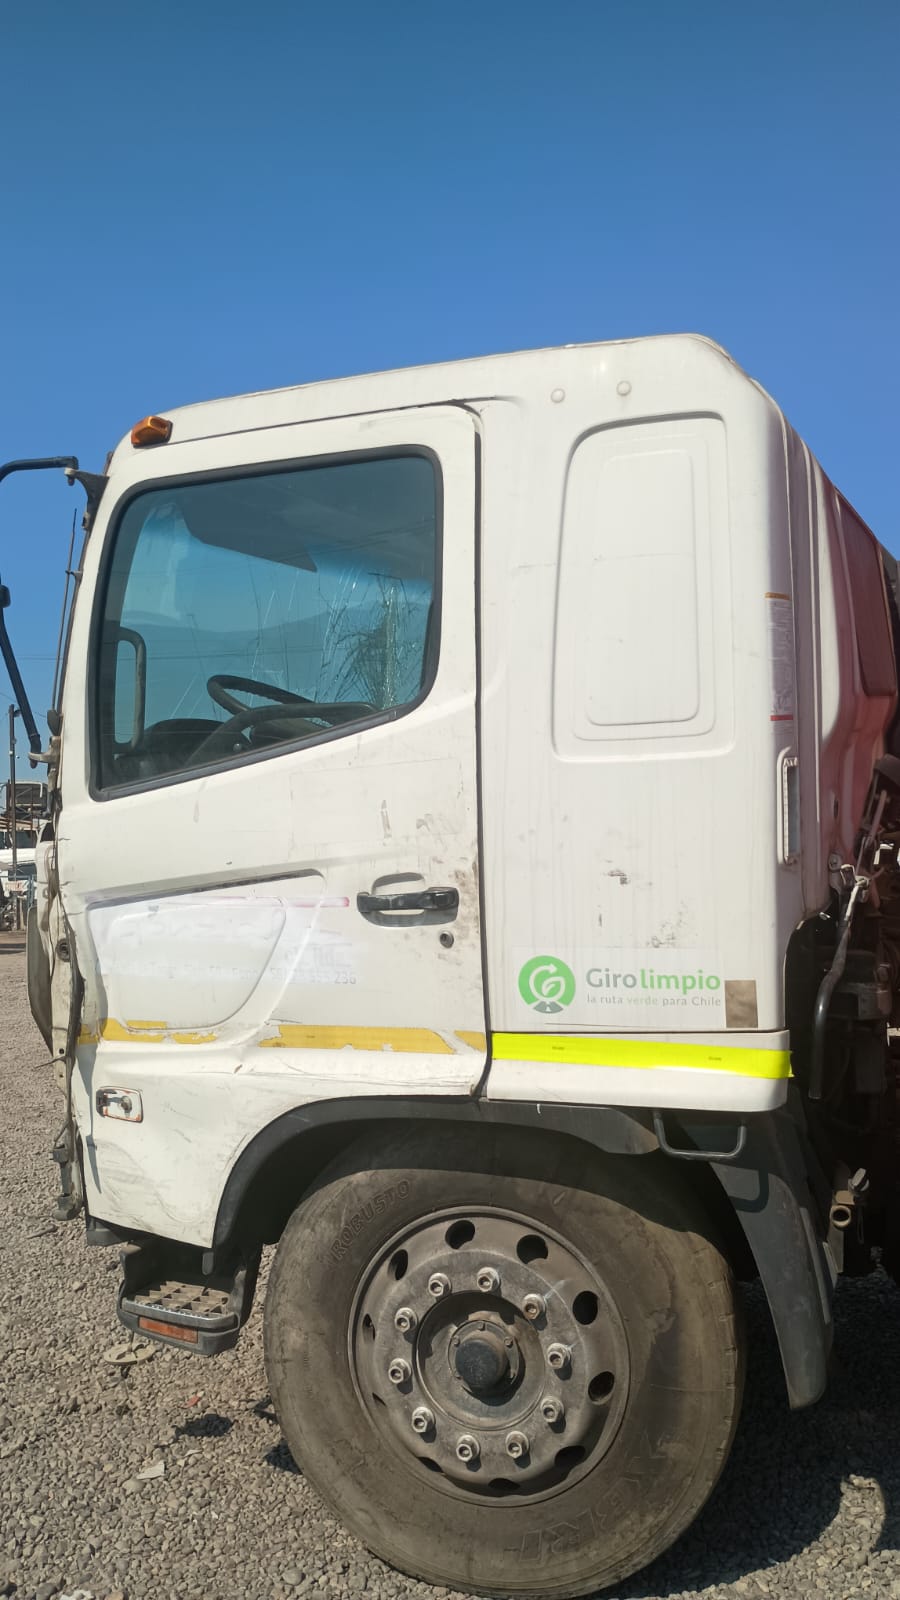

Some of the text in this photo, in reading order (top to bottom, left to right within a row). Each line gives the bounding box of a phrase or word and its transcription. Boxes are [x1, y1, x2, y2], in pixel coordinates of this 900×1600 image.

[587, 992, 721, 1007] la ruta verde para Chile
[329, 1179, 410, 1263] ROBUSTO
